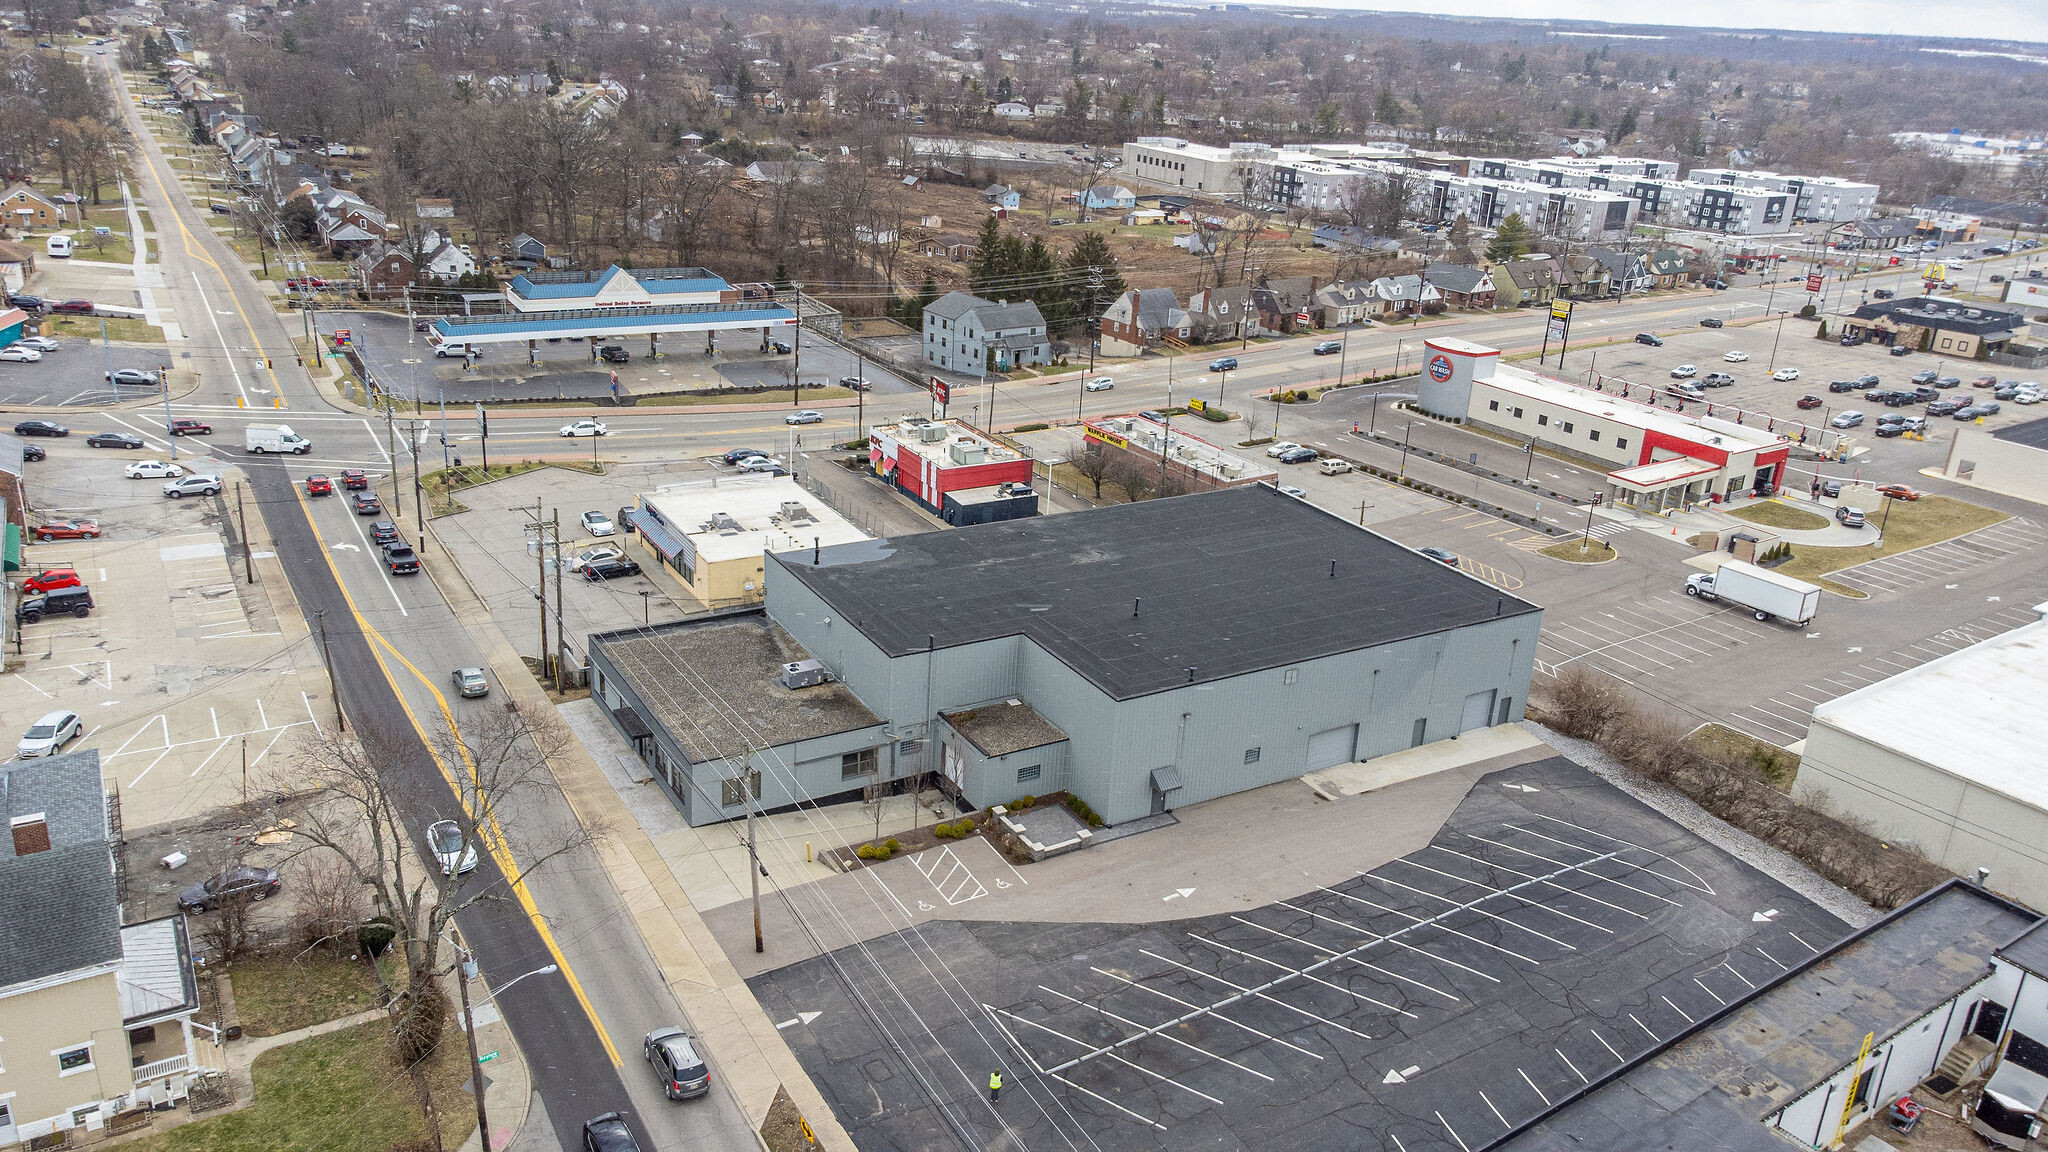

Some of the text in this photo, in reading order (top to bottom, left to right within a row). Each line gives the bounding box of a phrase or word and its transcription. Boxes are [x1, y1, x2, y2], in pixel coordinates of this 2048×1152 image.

[1429, 364, 1450, 375] CAR WASH
[937, 387, 946, 397] KFC
[871, 434, 883, 448] KFC
[1087, 426, 1122, 445] WAFFLE HOUSE
